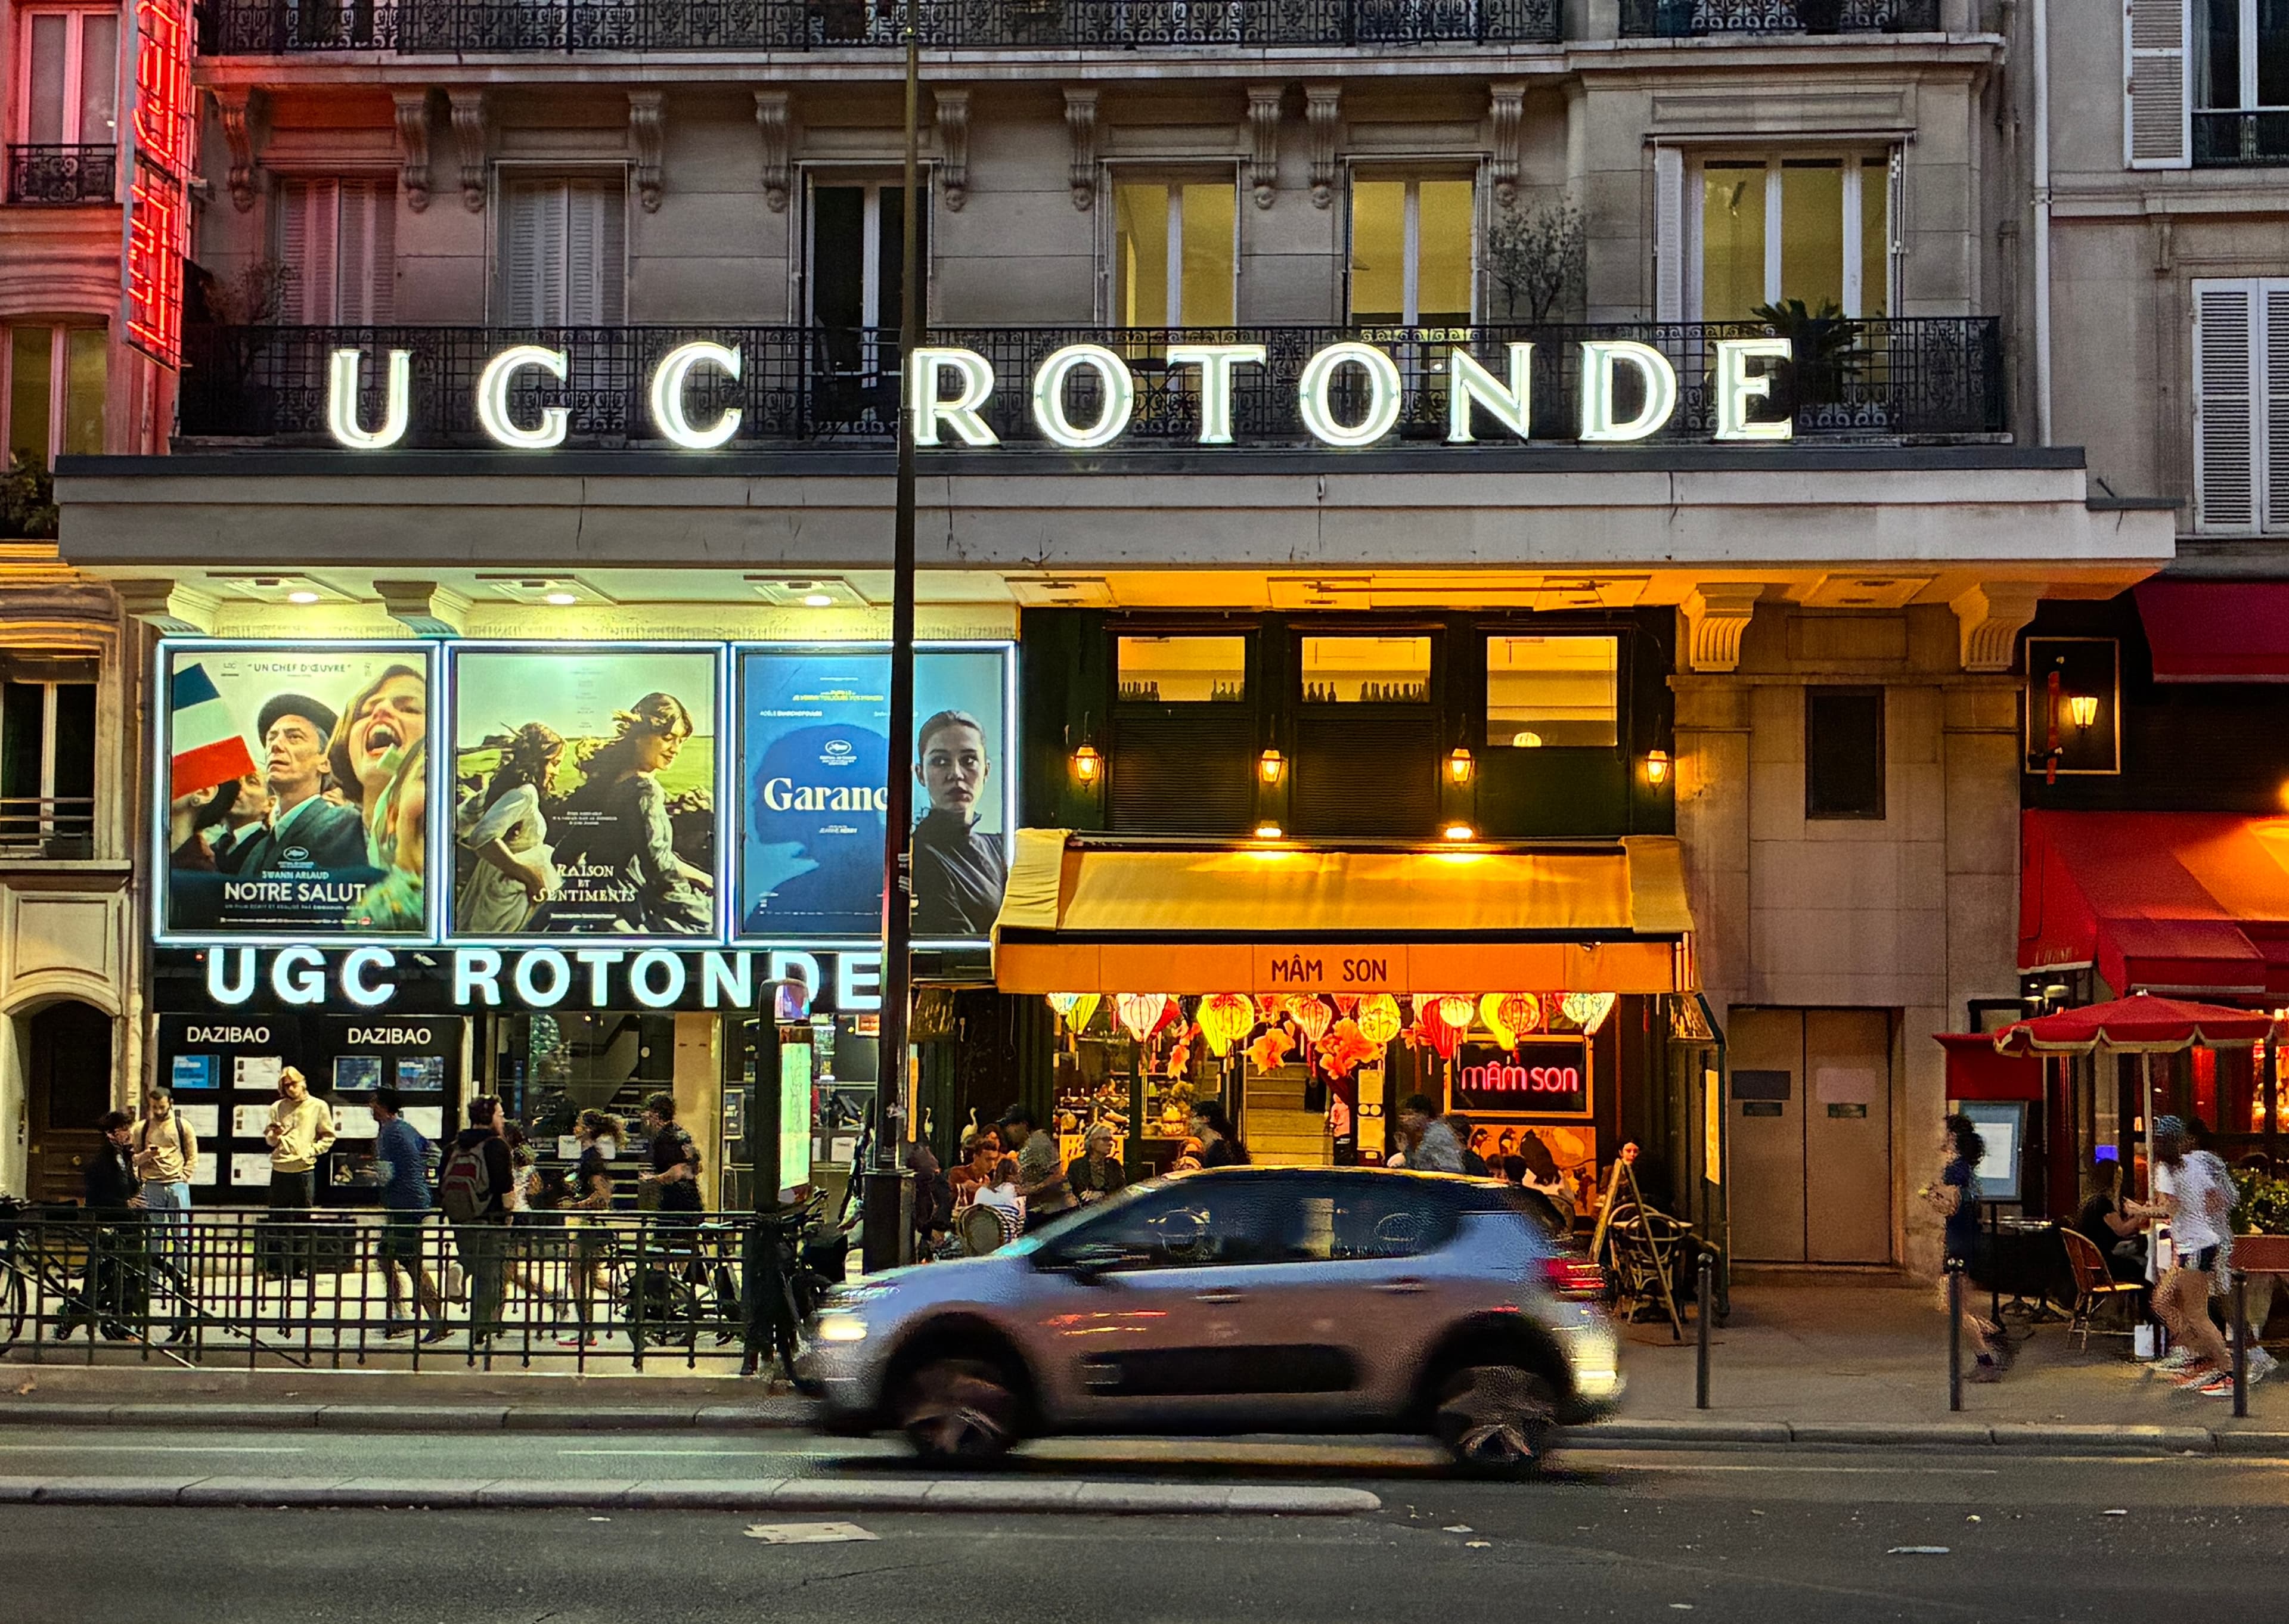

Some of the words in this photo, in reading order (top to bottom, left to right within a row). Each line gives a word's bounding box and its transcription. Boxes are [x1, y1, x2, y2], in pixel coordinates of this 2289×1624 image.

[327, 341, 743, 449] UGC
[910, 338, 1793, 448] ROTONDE
[272, 663, 297, 672] CHEF
[764, 777, 888, 811] Garanc
[557, 864, 615, 877] RAISON
[225, 881, 293, 902] NOTRE
[298, 883, 367, 902] SALUT
[532, 887, 635, 902] SENTIMENTS
[207, 945, 396, 1006] UGC
[454, 948, 882, 1010] ROTONDE
[1272, 954, 1323, 982] MÂM
[1342, 958, 1387, 982] SON
[187, 1026, 271, 1043] DAZIBAO
[348, 1027, 432, 1044] DAZIBAO
